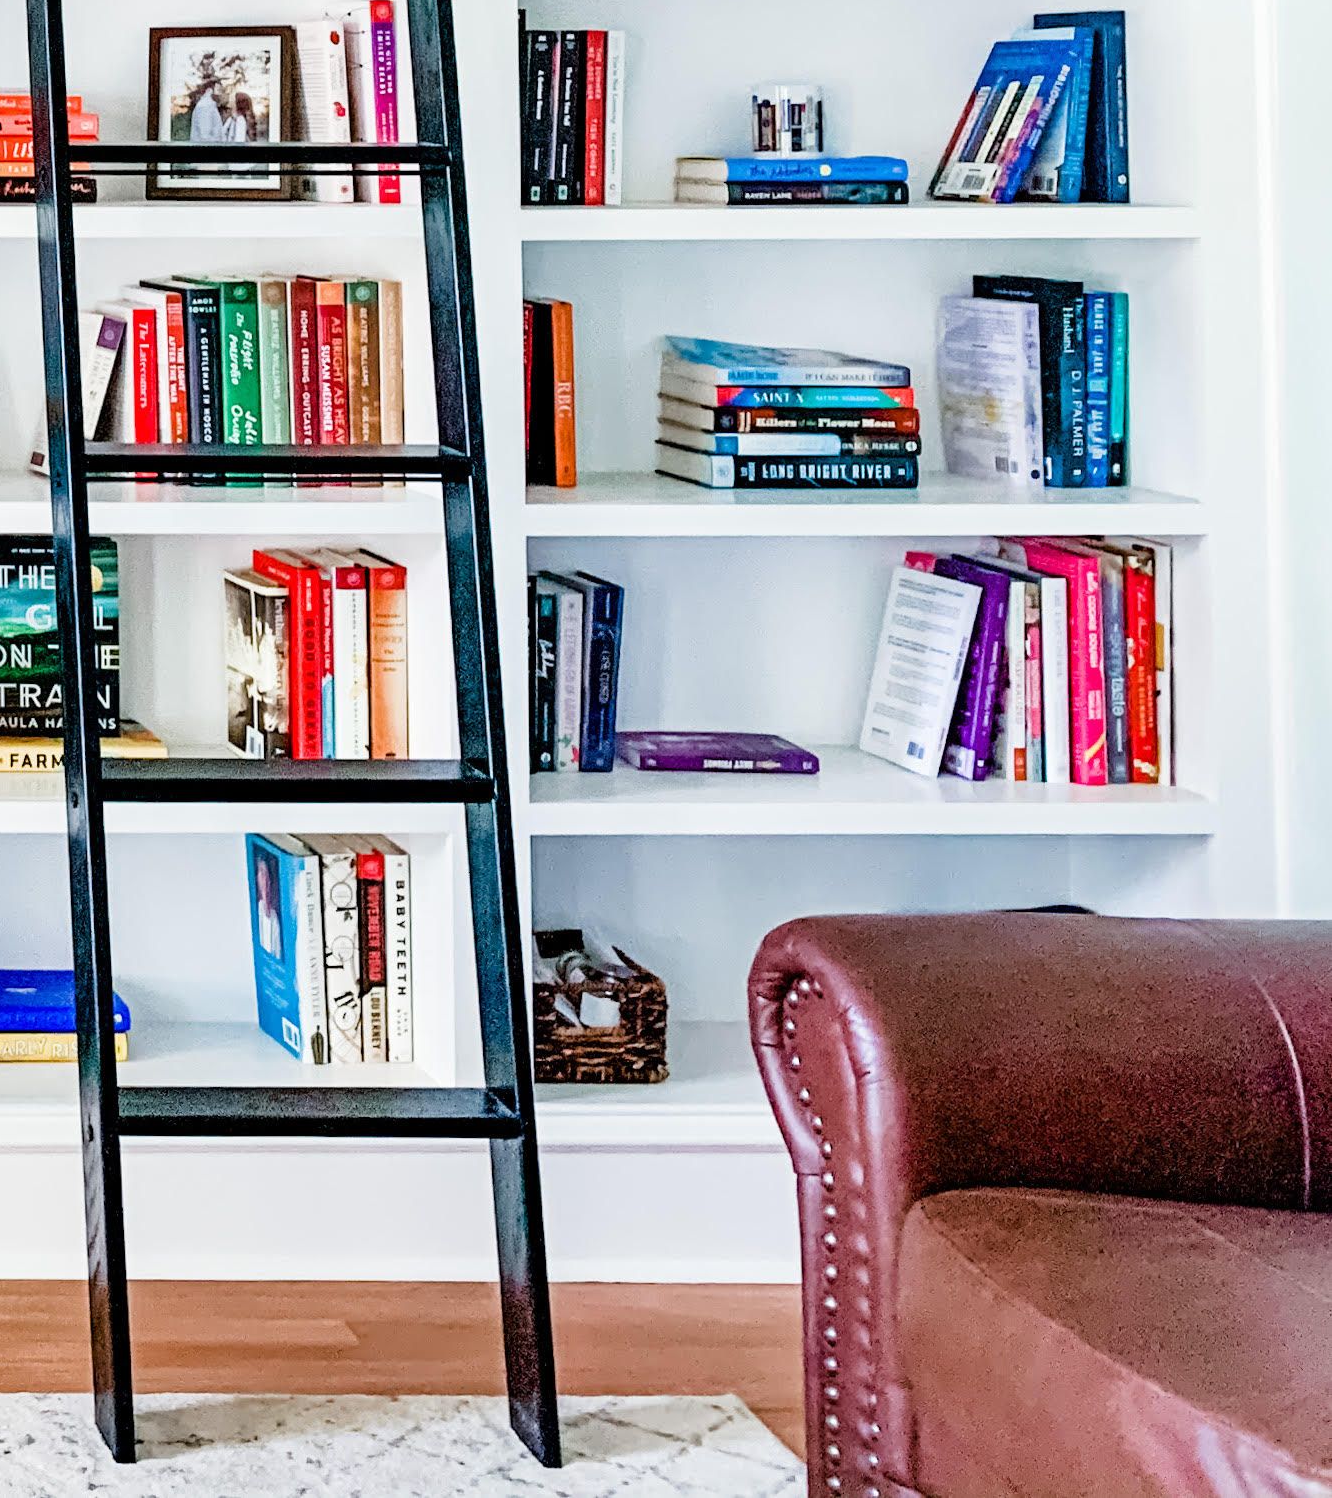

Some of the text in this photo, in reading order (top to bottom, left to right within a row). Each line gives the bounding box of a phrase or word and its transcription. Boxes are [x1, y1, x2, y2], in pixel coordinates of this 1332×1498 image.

[139, 344, 150, 408] Latecomers
[321, 345, 332, 431] SUSAN MEISSNER
[557, 381, 572, 418] RBG
[754, 393, 804, 402] SAINT X
[1072, 404, 1083, 456] PALMER
[762, 464, 891, 480] LONG BRIGHT RIVER
[9, 752, 65, 769] FARM
[366, 885, 382, 982] NOVEMBER ROAD
[395, 880, 407, 996] BABY TEETH
[370, 991, 382, 1049] LOU BERNEY
